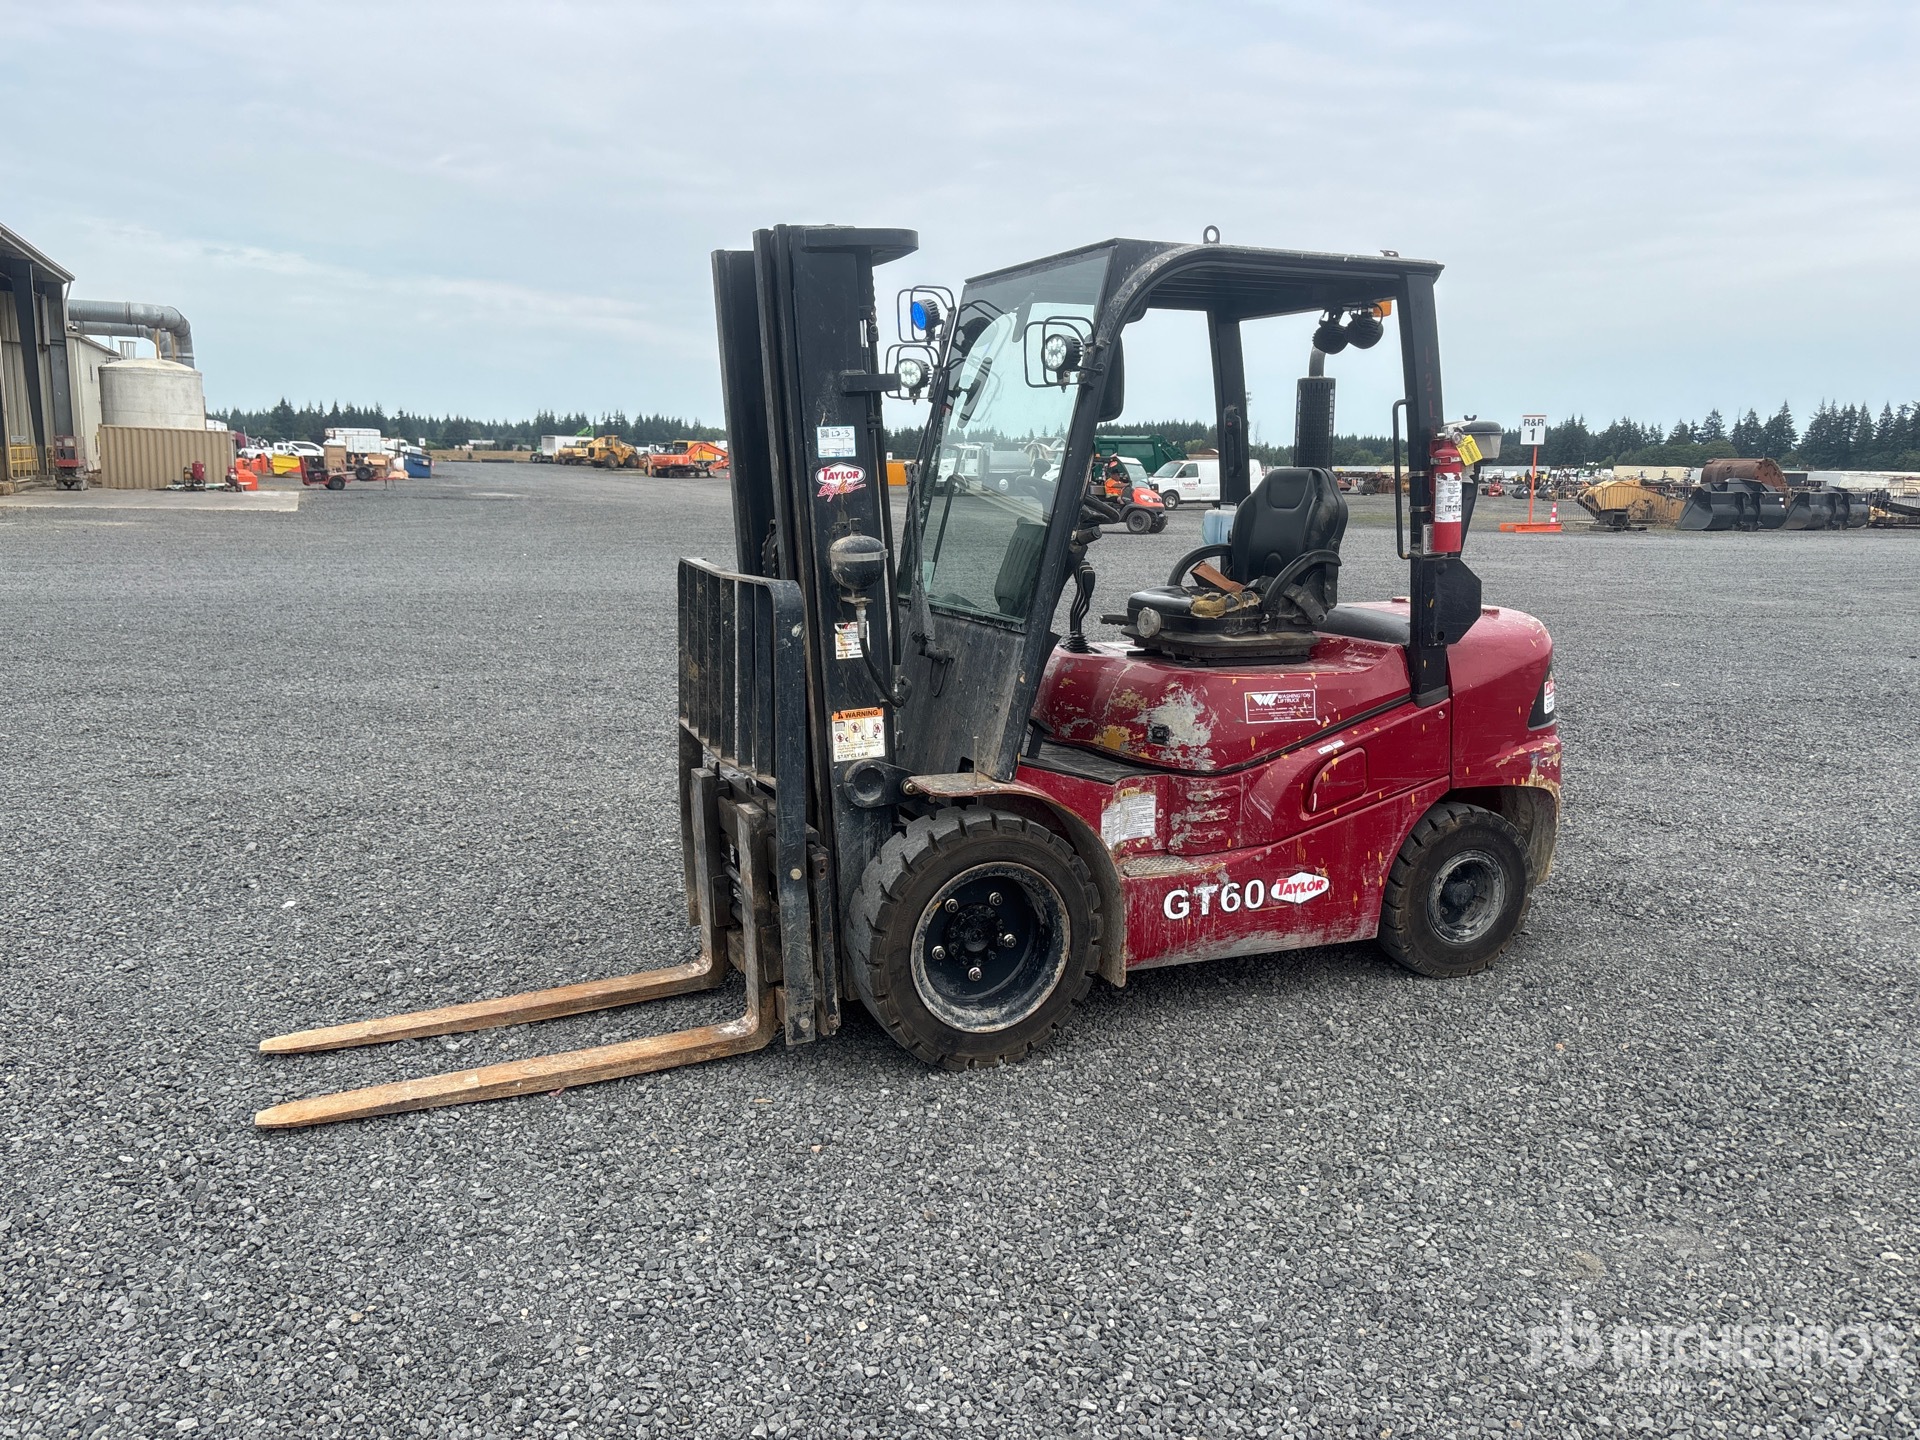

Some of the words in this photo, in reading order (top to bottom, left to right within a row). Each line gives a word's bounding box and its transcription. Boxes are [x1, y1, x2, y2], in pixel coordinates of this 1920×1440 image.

[1530, 428, 1535, 441] 1
[822, 468, 859, 480] TAYLOR
[845, 710, 878, 718] WARNING
[1163, 879, 1266, 920] GT60
[1277, 879, 1325, 896] TAYLOR
